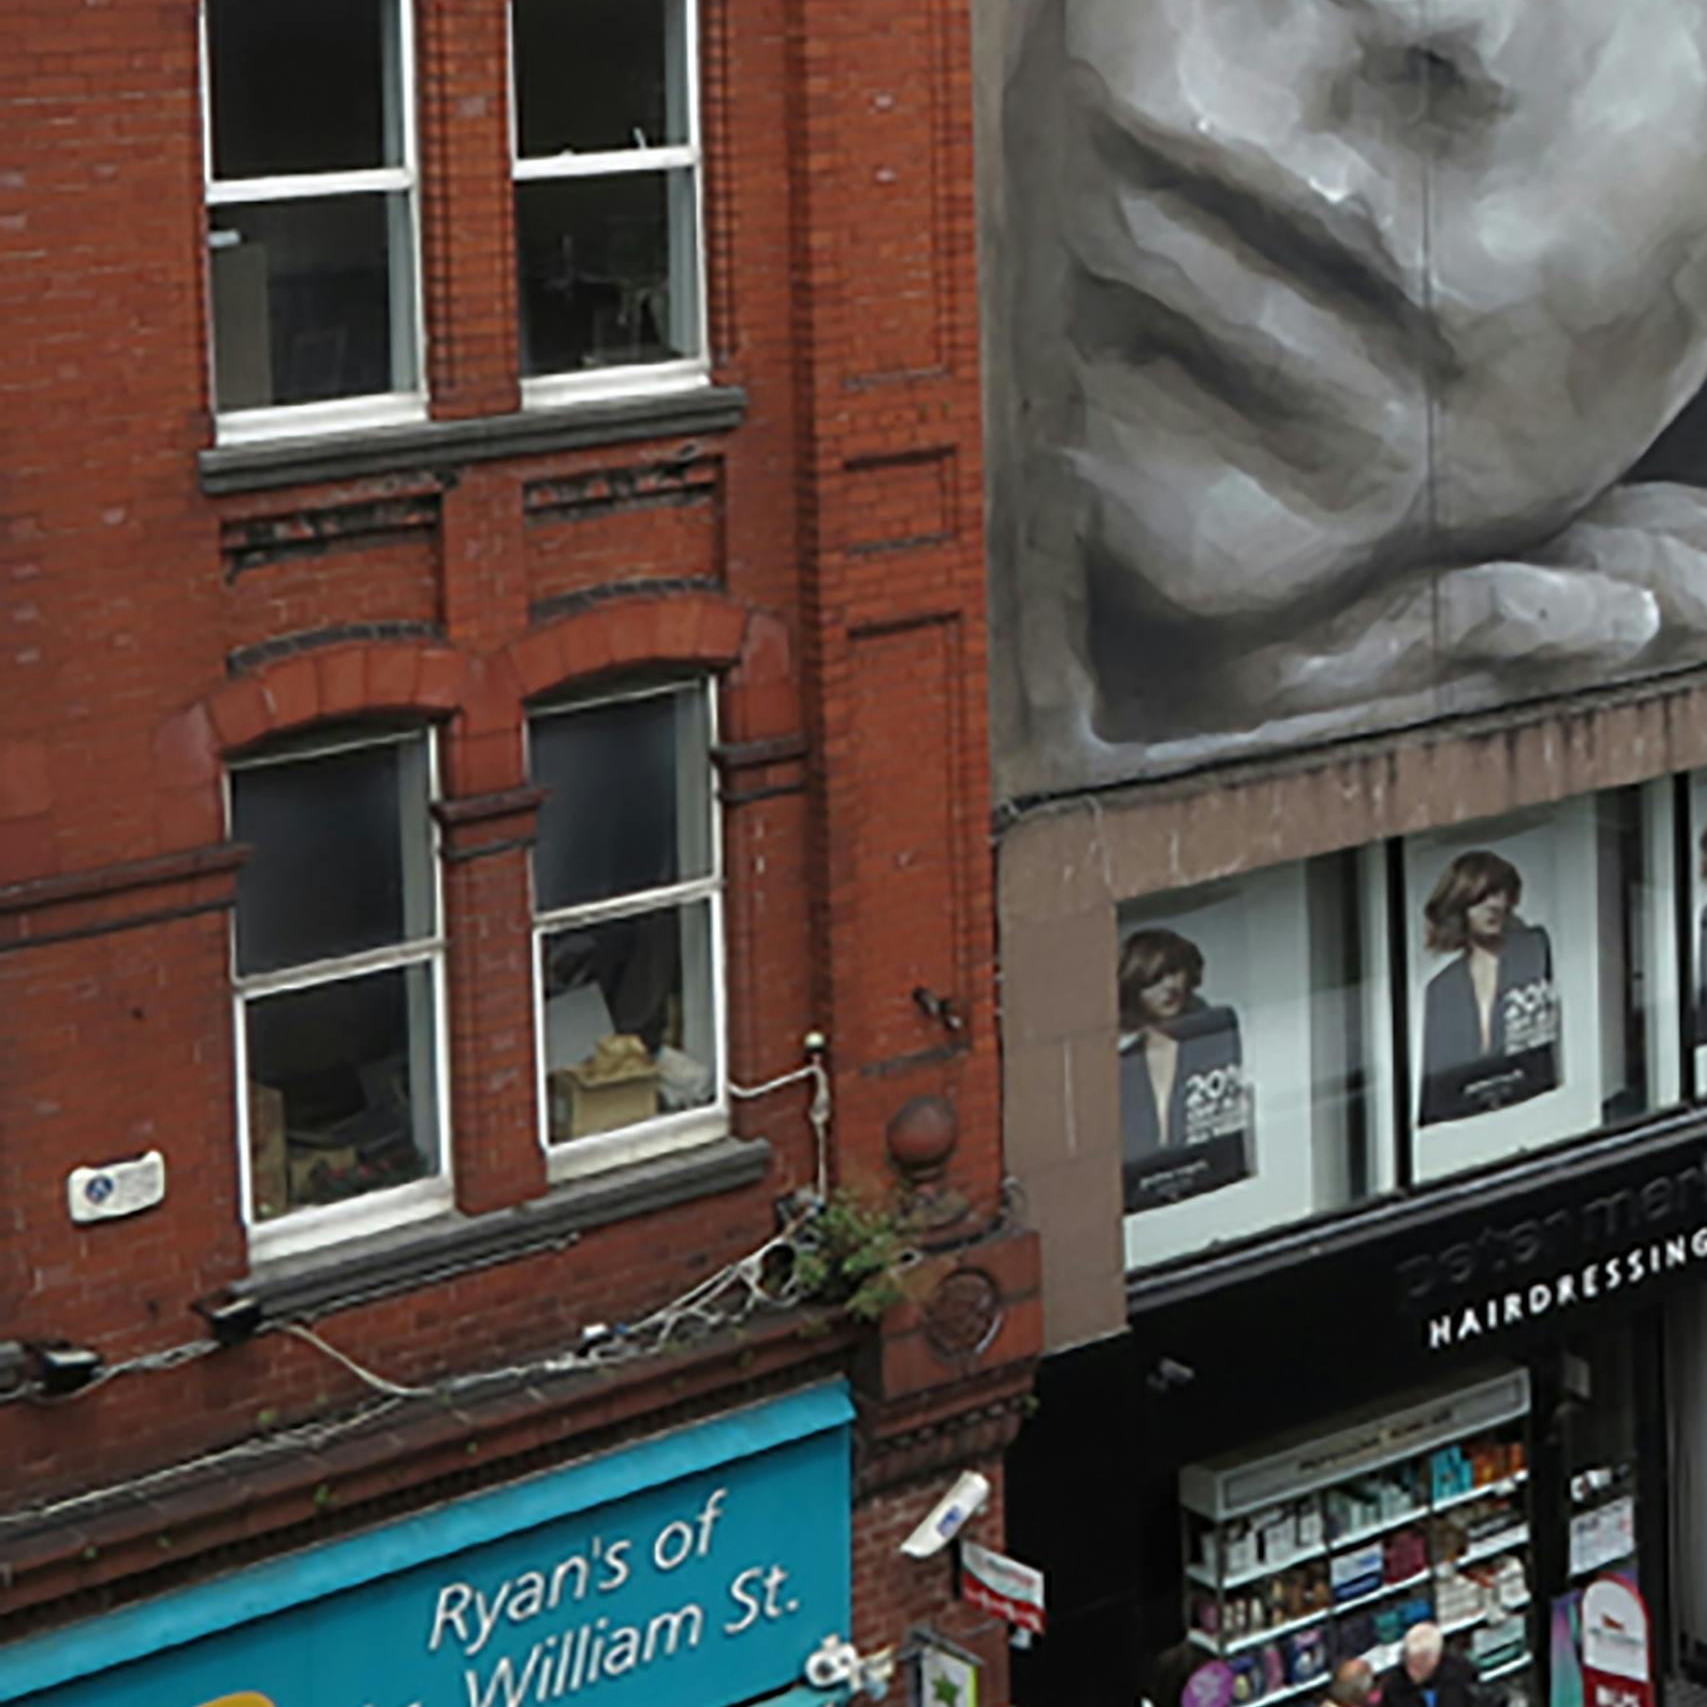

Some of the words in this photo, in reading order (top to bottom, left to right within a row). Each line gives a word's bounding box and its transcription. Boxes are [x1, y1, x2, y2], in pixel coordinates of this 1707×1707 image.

[428, 1536, 632, 1656] Ryan's
[653, 1488, 728, 1571] of
[465, 1602, 703, 1707] William
[723, 1564, 800, 1634] St.
